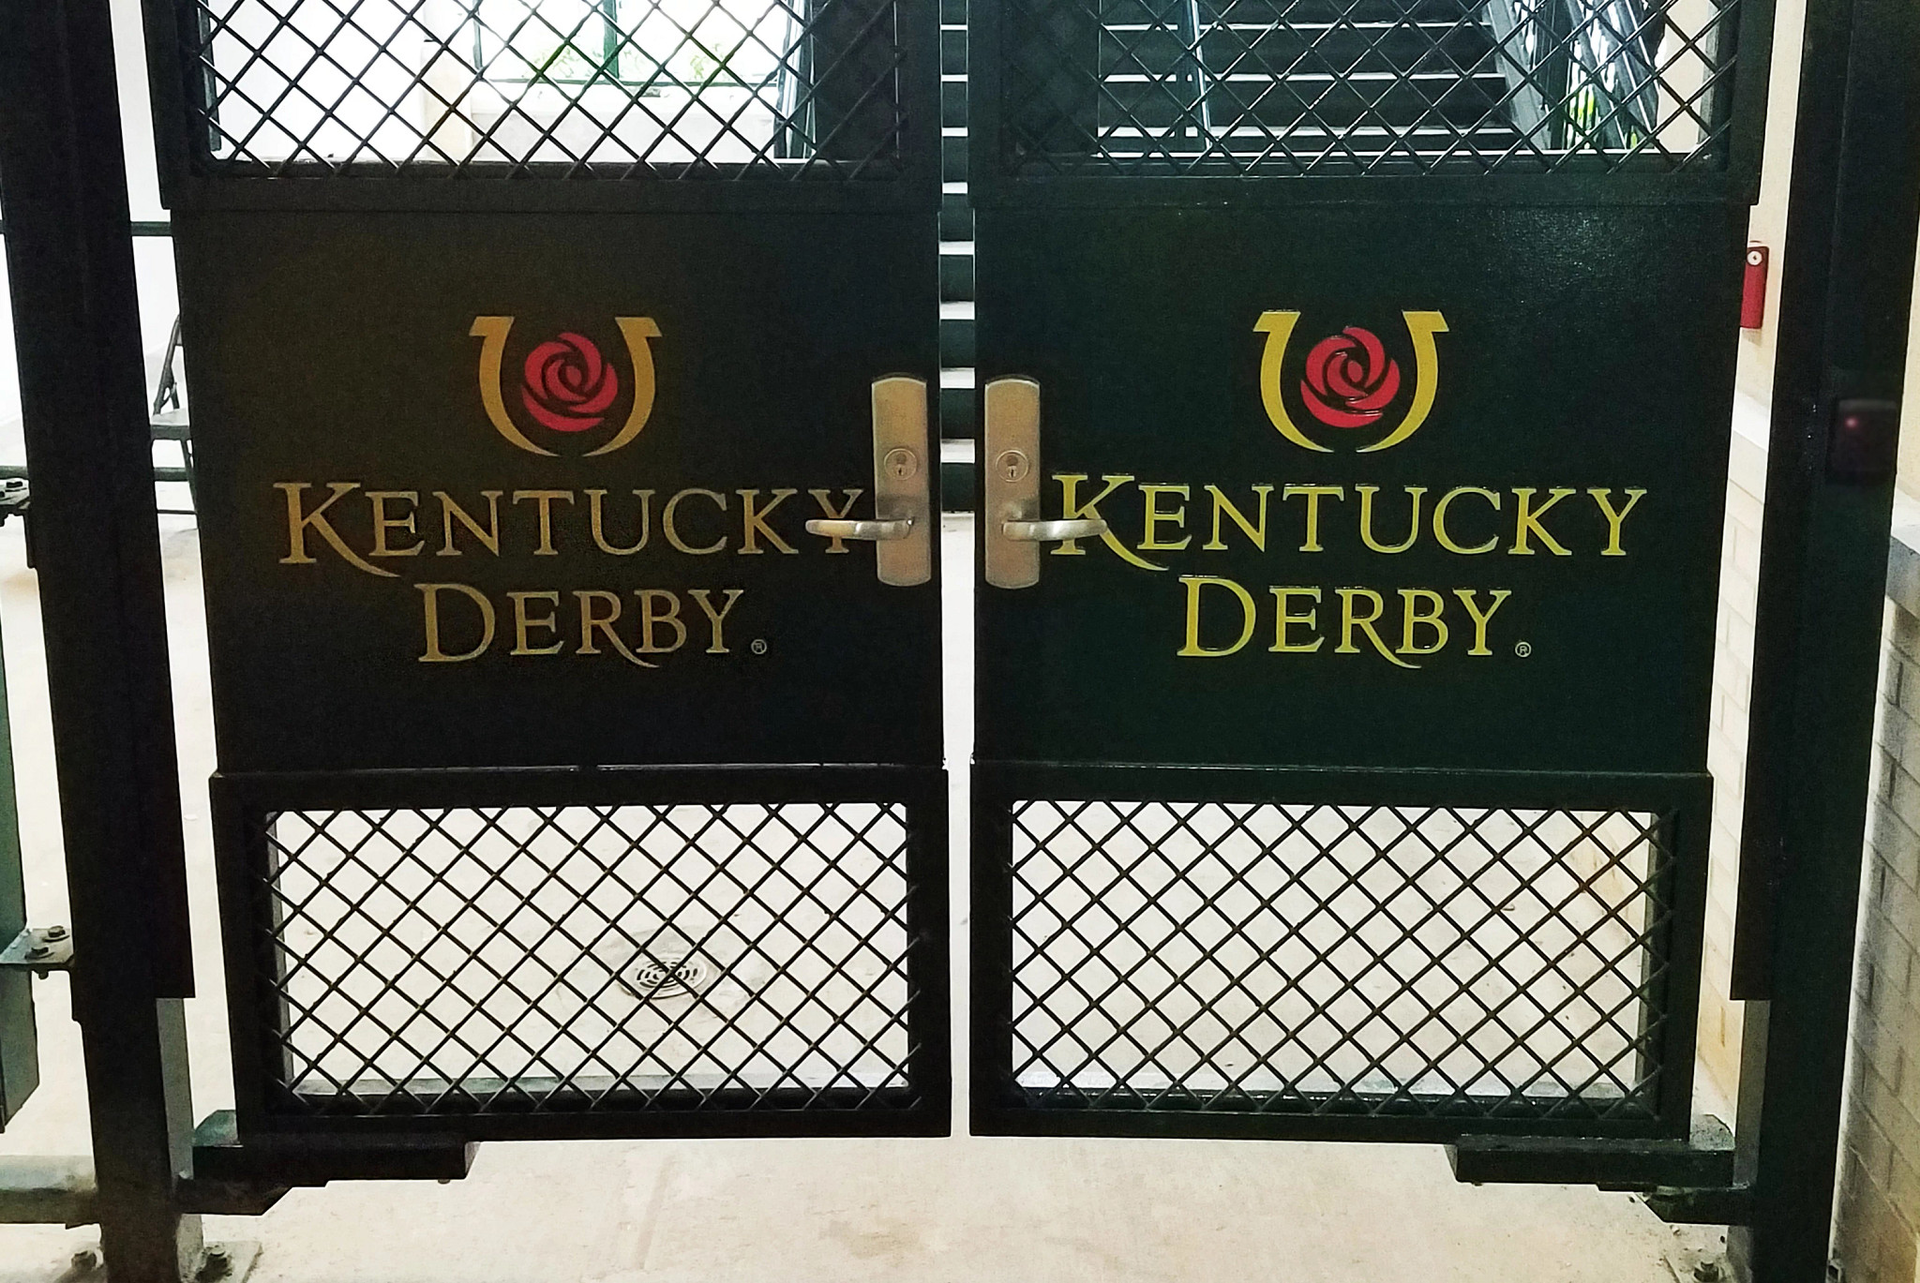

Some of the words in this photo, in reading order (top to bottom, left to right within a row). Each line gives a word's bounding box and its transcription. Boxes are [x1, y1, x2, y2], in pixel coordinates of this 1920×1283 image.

[273, 481, 864, 578] KENTUCKY
[1050, 473, 1648, 572] KENTUCKY
[414, 583, 745, 669] DERBY
[1177, 574, 1512, 669] DERBY
